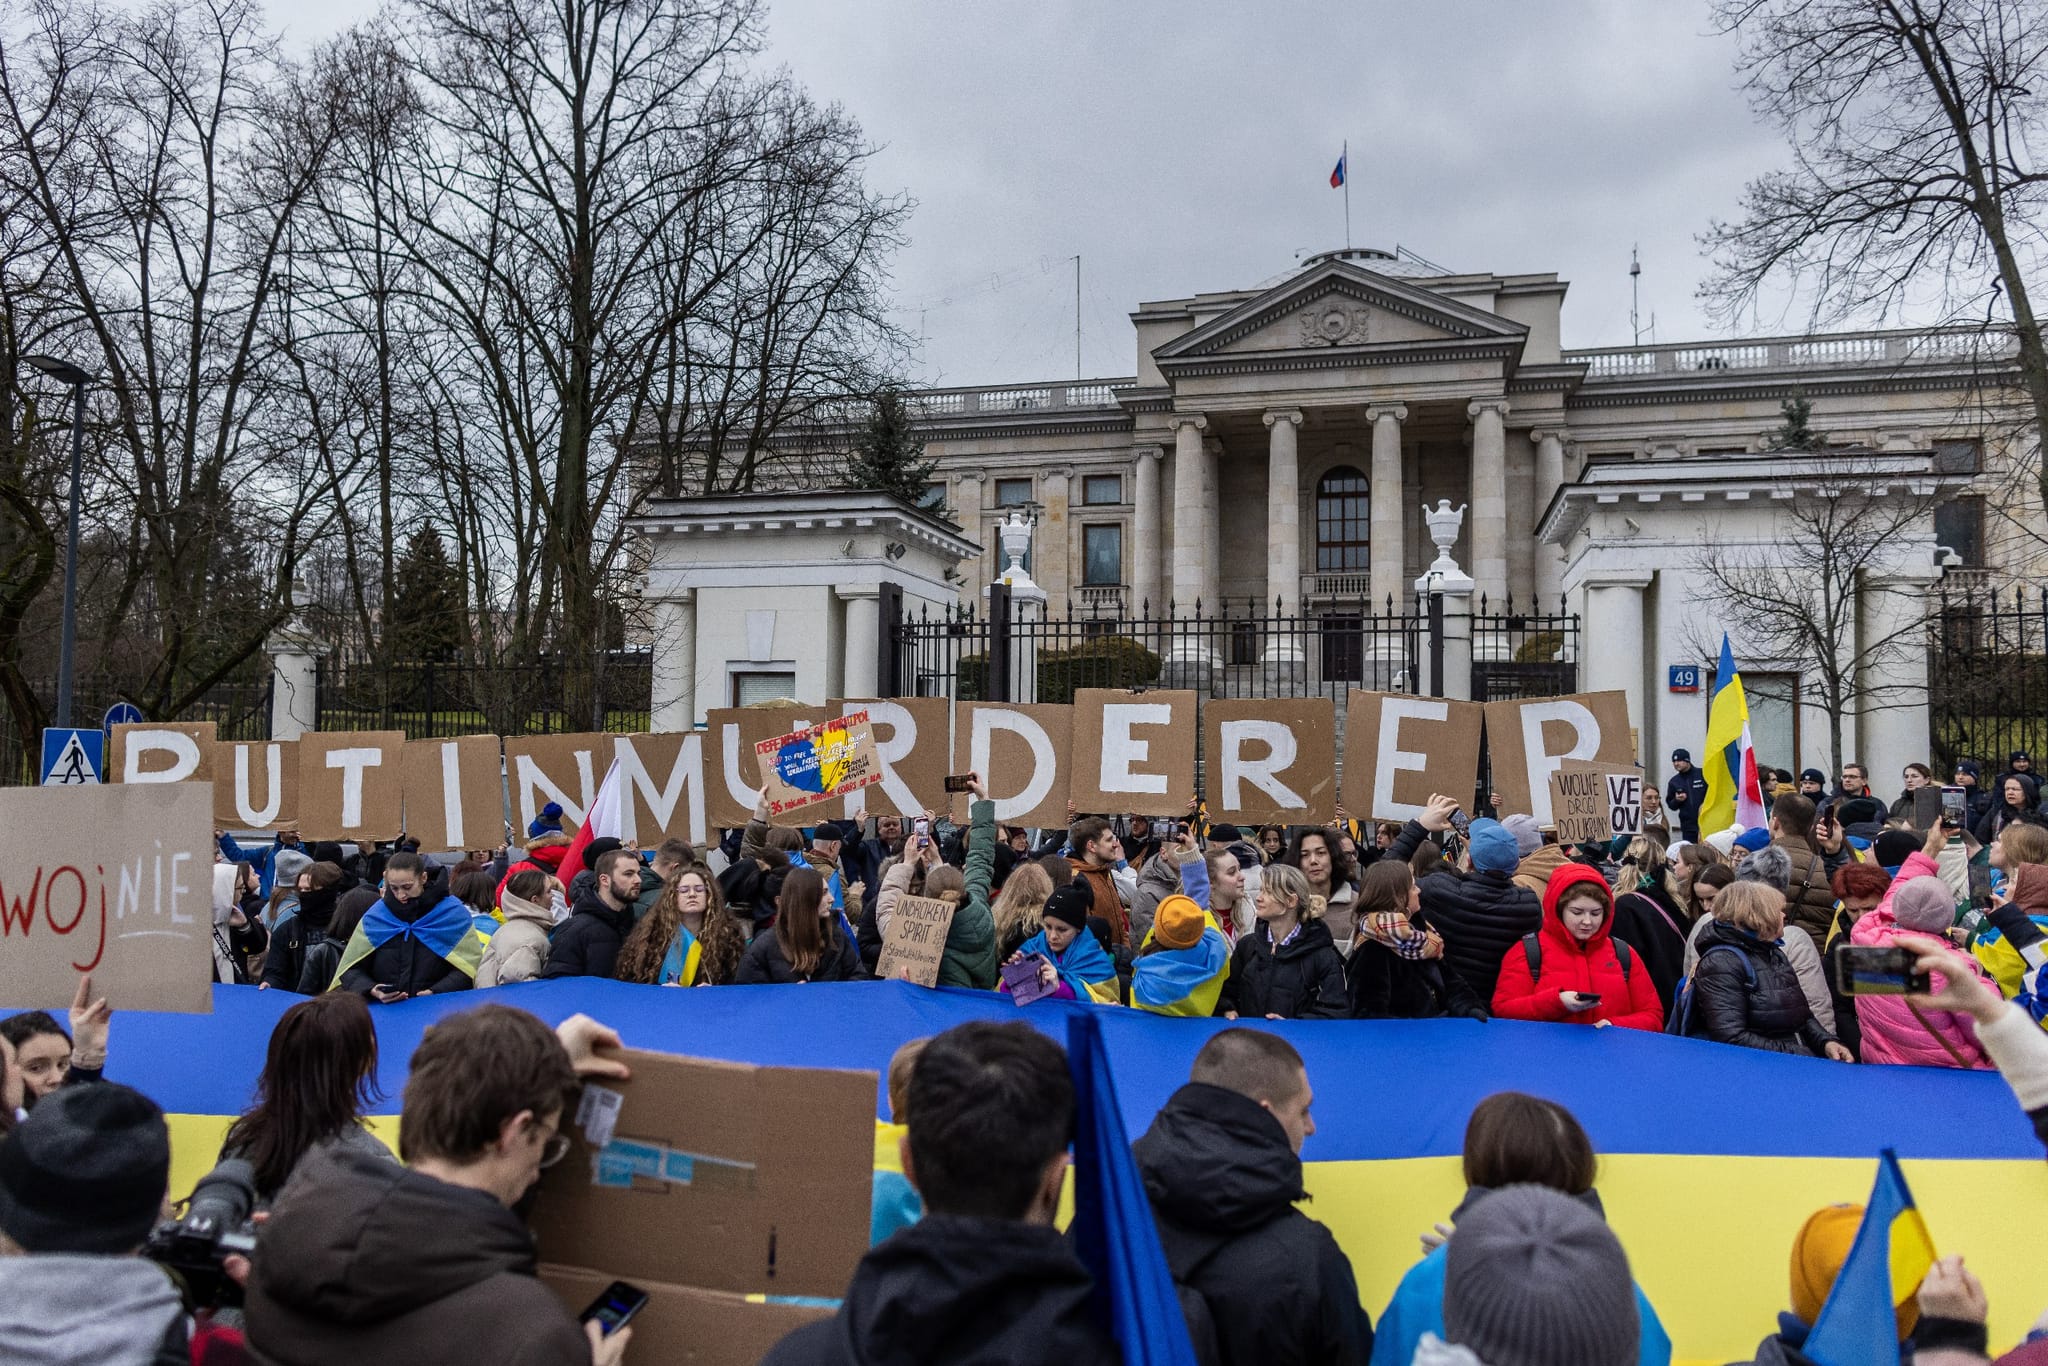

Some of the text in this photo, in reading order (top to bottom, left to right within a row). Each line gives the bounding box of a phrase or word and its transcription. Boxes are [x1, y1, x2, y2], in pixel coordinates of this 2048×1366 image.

[1674, 671, 1694, 686] 49
[757, 728, 811, 754] DEFENDERS
[813, 723, 825, 737] OF
[770, 799, 784, 816] 36
[837, 781, 857, 795] CORPS
[859, 777, 869, 787] OF
[1557, 773, 1599, 797] WOLNE
[1607, 776, 1640, 805] VE
[896, 899, 950, 923] UNBROKEN
[900, 920, 933, 943] SPIRIT
